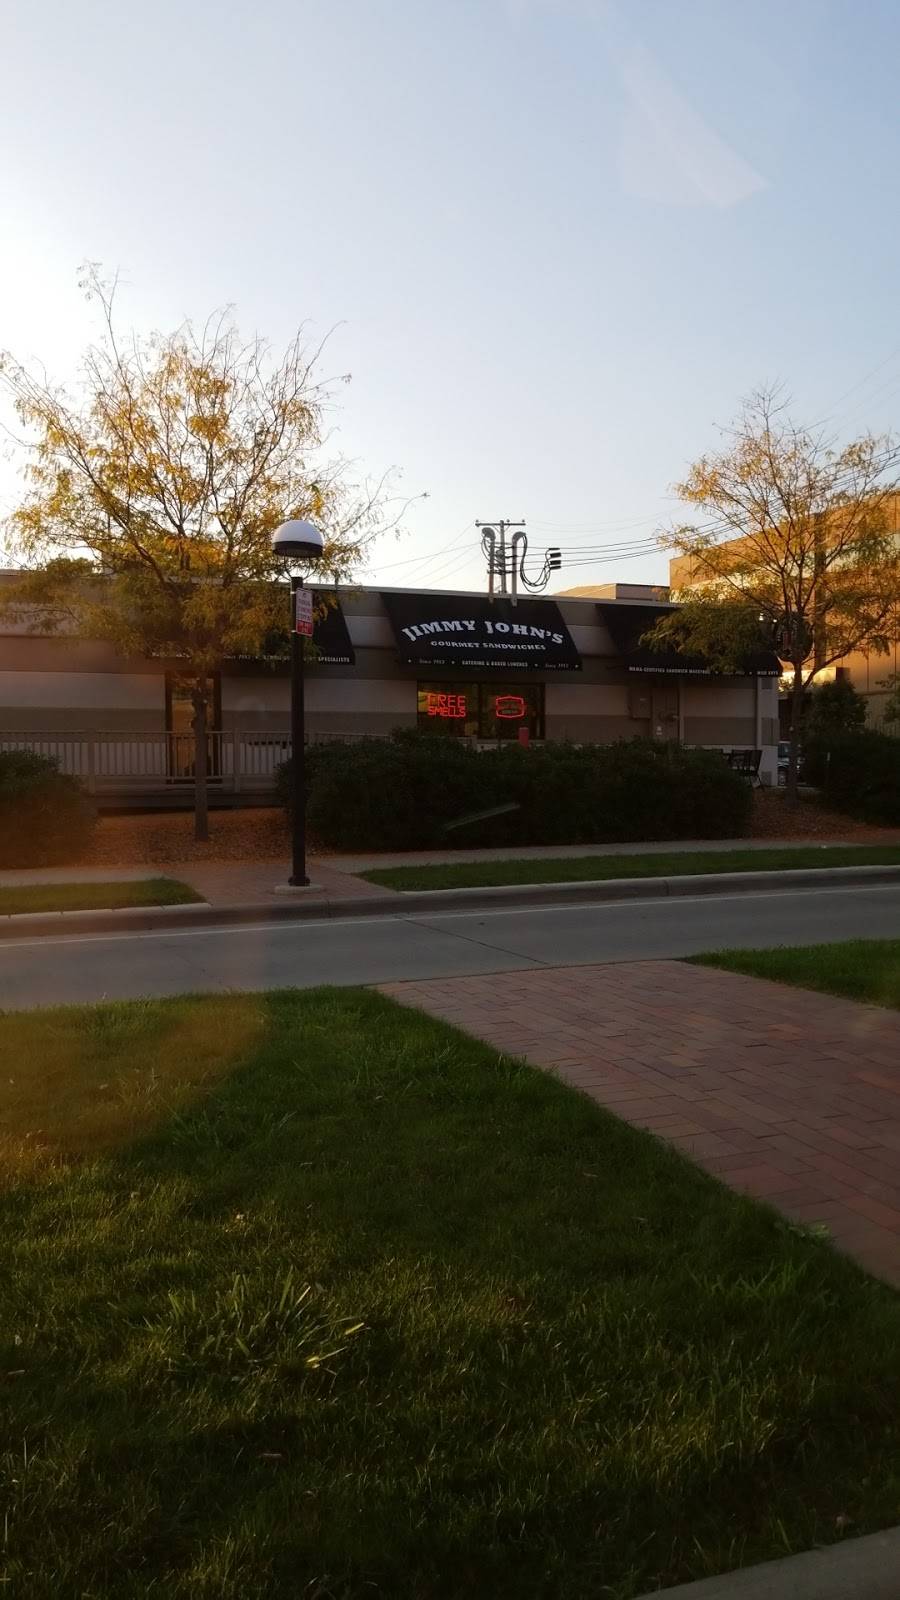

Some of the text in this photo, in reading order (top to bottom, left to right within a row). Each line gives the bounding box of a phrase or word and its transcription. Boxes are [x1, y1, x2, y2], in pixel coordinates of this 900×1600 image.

[402, 620, 564, 644] JIMMY JOHN'S
[430, 640, 546, 650] GOURMET SANDWICHES
[427, 694, 466, 707] FREE
[427, 706, 466, 717] SMELLS
